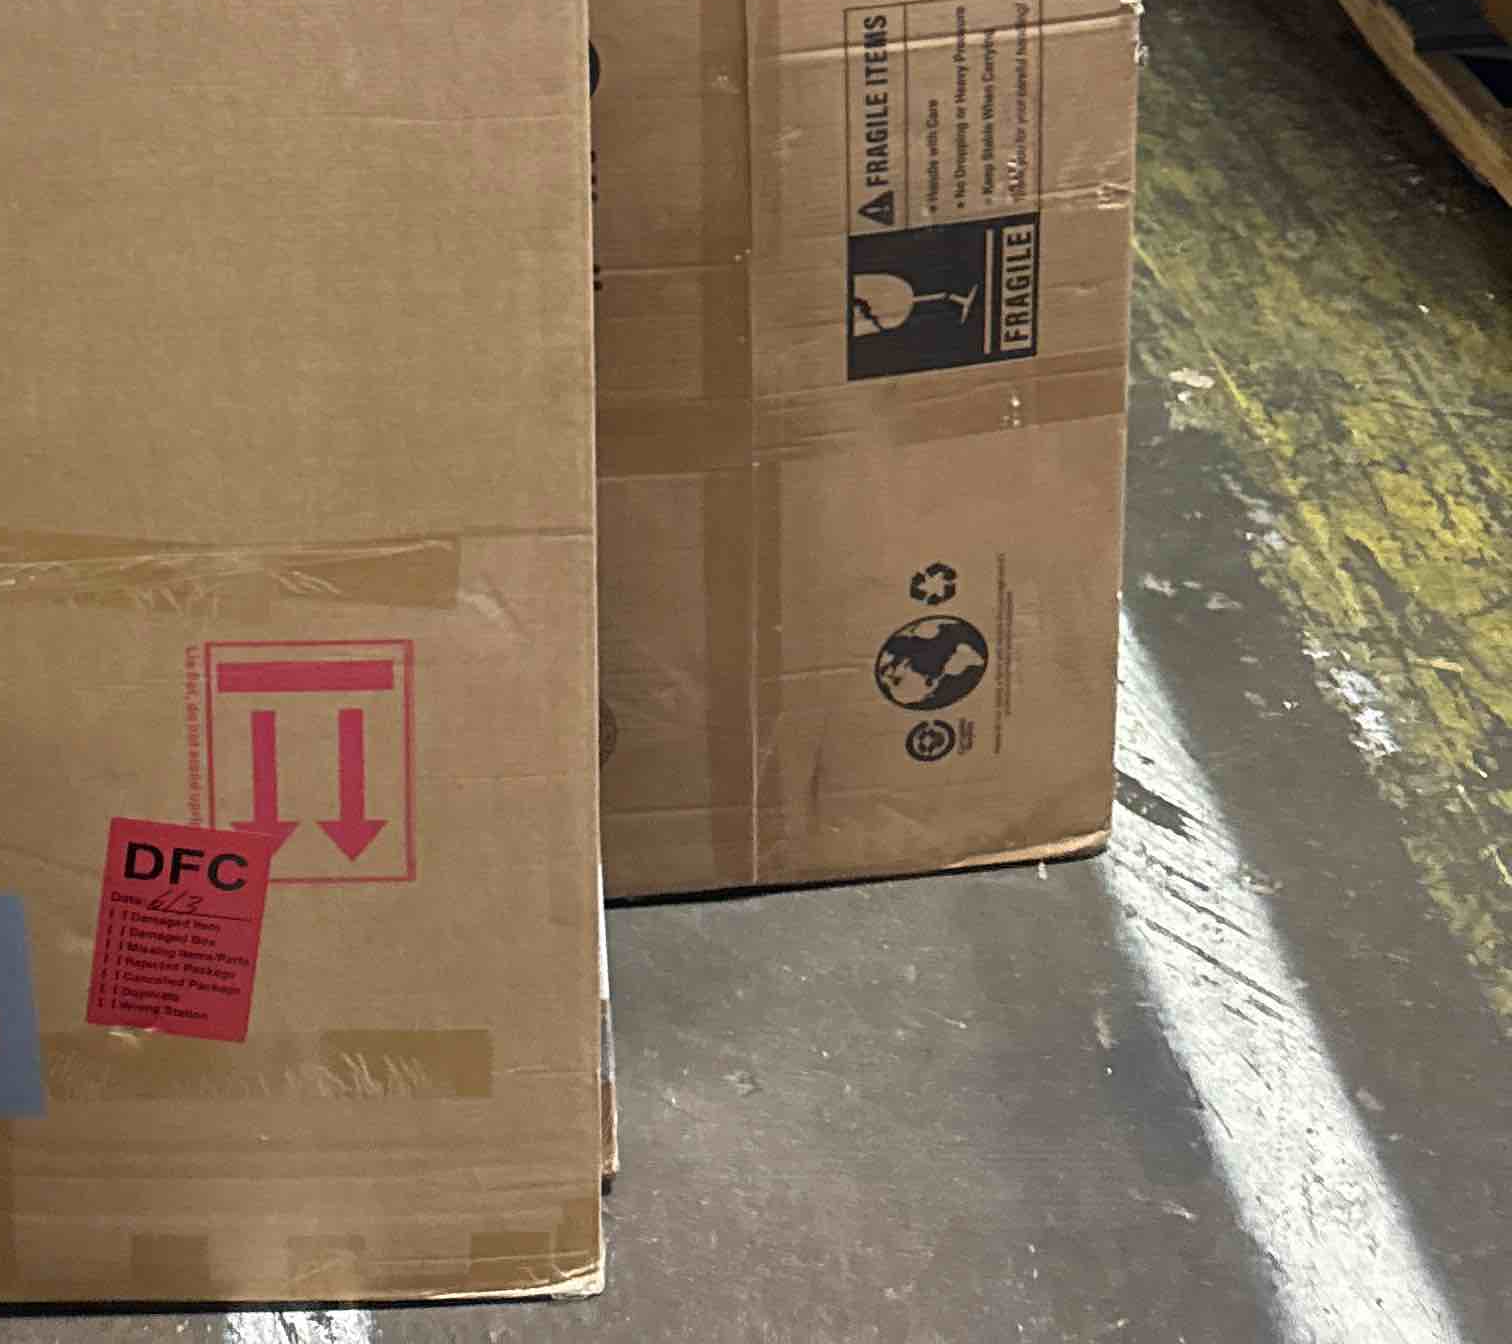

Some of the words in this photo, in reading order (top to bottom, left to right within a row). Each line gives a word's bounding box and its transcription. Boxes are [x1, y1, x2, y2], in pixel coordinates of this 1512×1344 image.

[863, 14, 888, 86] ITEMS
[981, 28, 996, 82] Carryin
[955, 66, 969, 104] Heavy
[956, 106, 967, 119] or
[865, 92, 889, 188] FRAGILE
[954, 122, 969, 179] Dropping
[954, 180, 967, 200] No
[1003, 231, 1032, 342] FRAGILE
[123, 841, 249, 891] DFC
